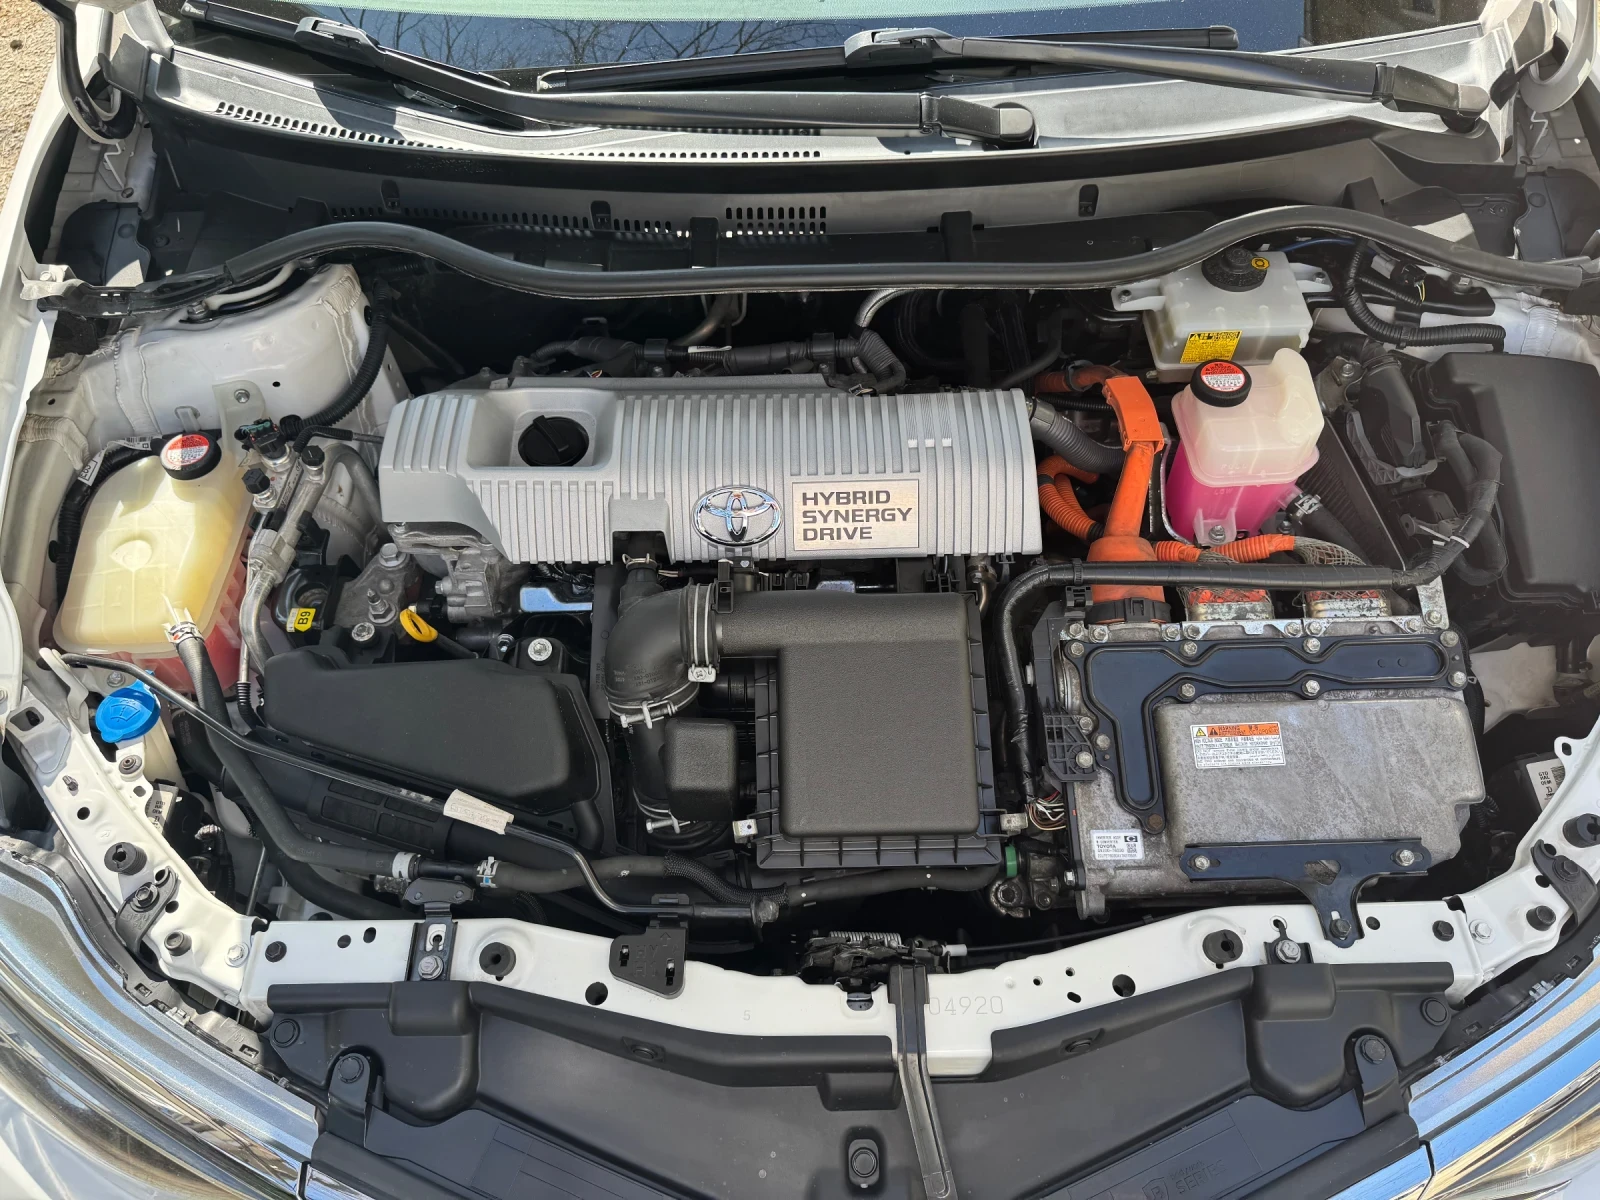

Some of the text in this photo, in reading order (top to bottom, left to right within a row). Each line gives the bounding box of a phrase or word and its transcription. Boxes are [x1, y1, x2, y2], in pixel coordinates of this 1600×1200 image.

[802, 490, 891, 506] HYBRID
[802, 507, 913, 524] SYNERGY
[802, 526, 873, 542] DRIVE
[297, 611, 311, 625] B9
[927, 996, 1004, 1016] 04920
